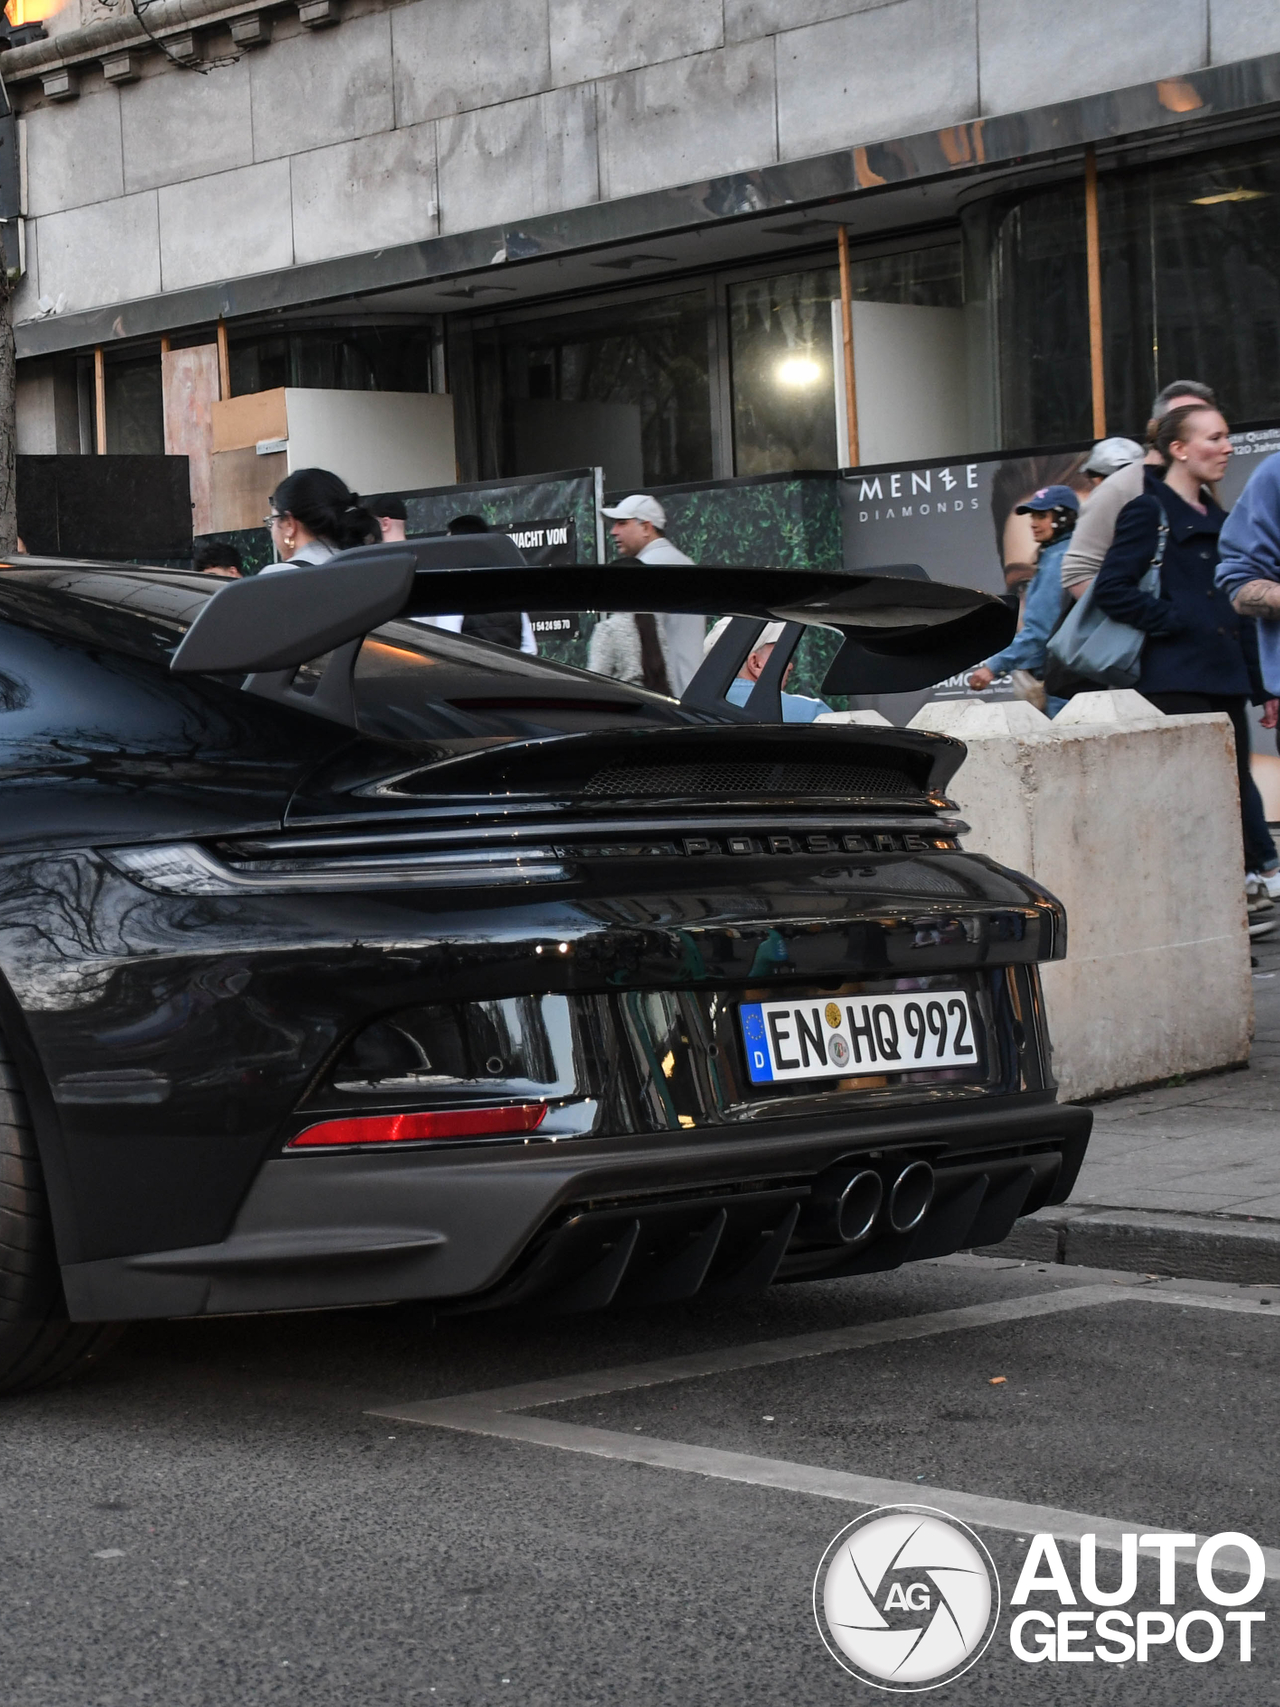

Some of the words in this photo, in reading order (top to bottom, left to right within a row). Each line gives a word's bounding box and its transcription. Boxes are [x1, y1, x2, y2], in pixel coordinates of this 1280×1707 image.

[858, 464, 979, 502] MENZE
[859, 498, 979, 523] DIAMONDS
[545, 527, 568, 546] VON
[682, 835, 926, 856] PORSCHE
[819, 865, 878, 879] GT3
[767, 1007, 829, 1071] EN
[845, 1003, 902, 1064] HQ
[903, 999, 974, 1059] 992
[753, 1051, 765, 1069] D
